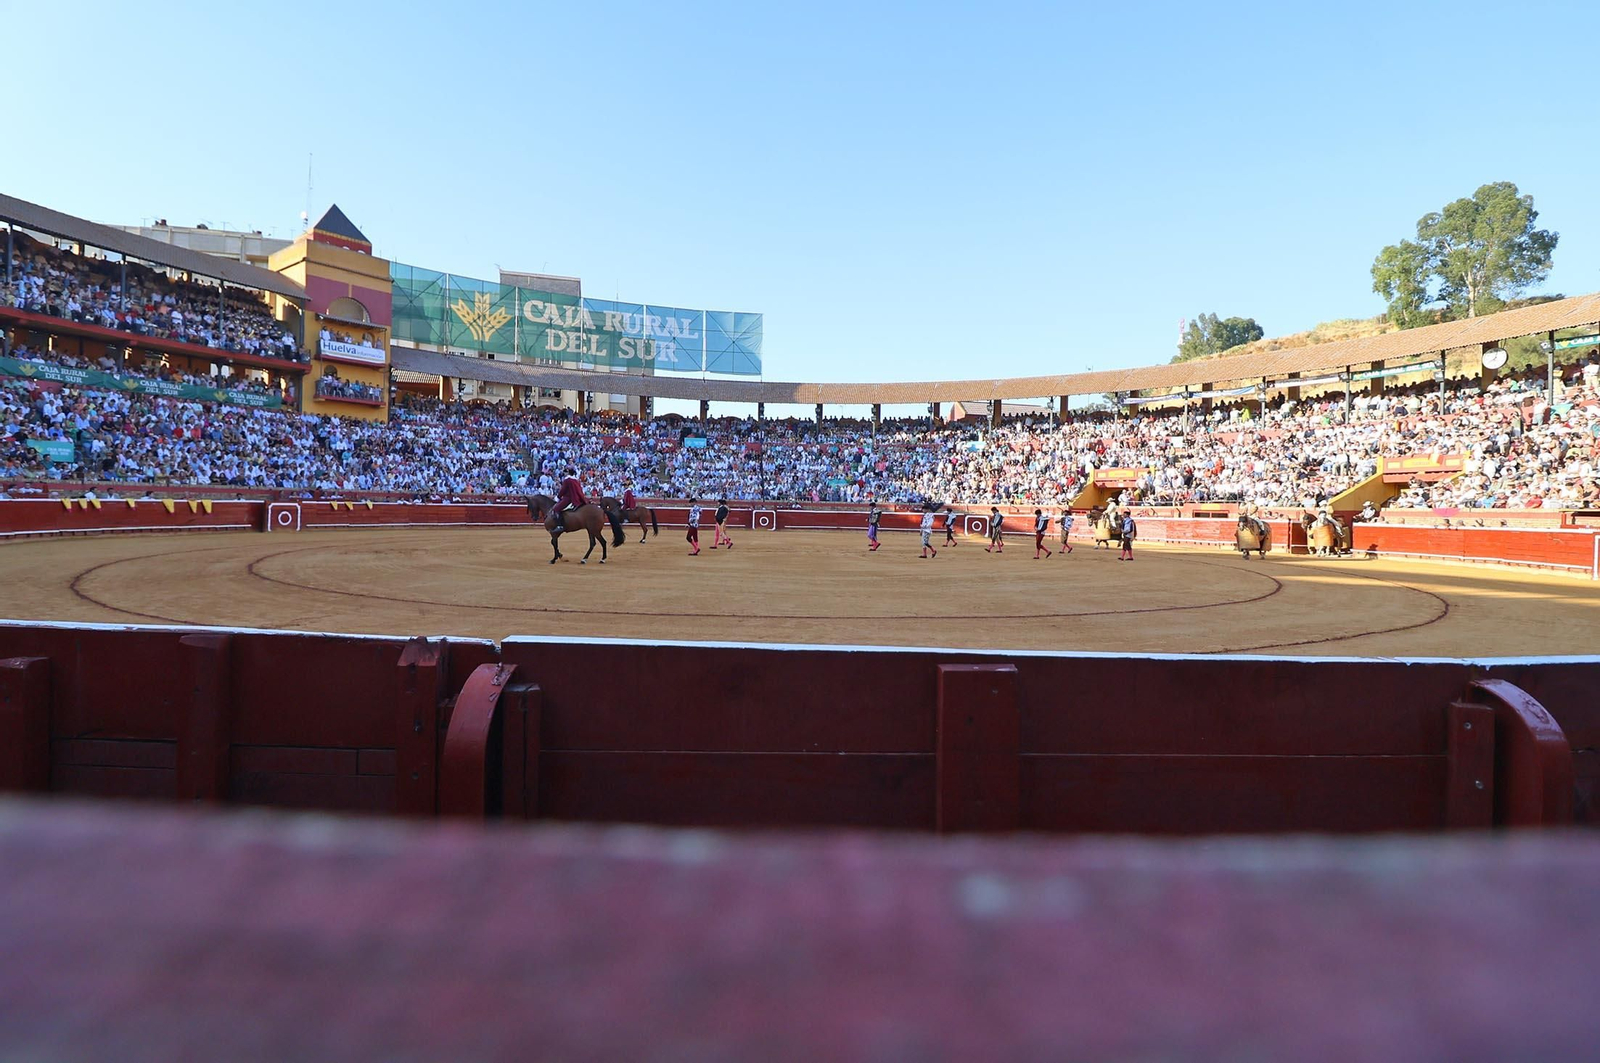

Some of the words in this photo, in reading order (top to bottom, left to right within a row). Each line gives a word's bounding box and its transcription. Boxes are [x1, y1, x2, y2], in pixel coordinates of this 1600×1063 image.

[523, 300, 596, 329] CAJA
[603, 310, 699, 339] RURAL
[323, 342, 356, 354] Huelva
[545, 328, 607, 356] DEL
[618, 337, 679, 362] SUR
[38, 365, 59, 374] CAJA
[61, 368, 88, 378] RURAL
[45, 373, 63, 381] DEL
[65, 375, 82, 383] SUR
[140, 380, 158, 388] CAJA
[160, 382, 184, 391] RURAL
[145, 386, 161, 394] DEL
[163, 388, 179, 396] SUR
